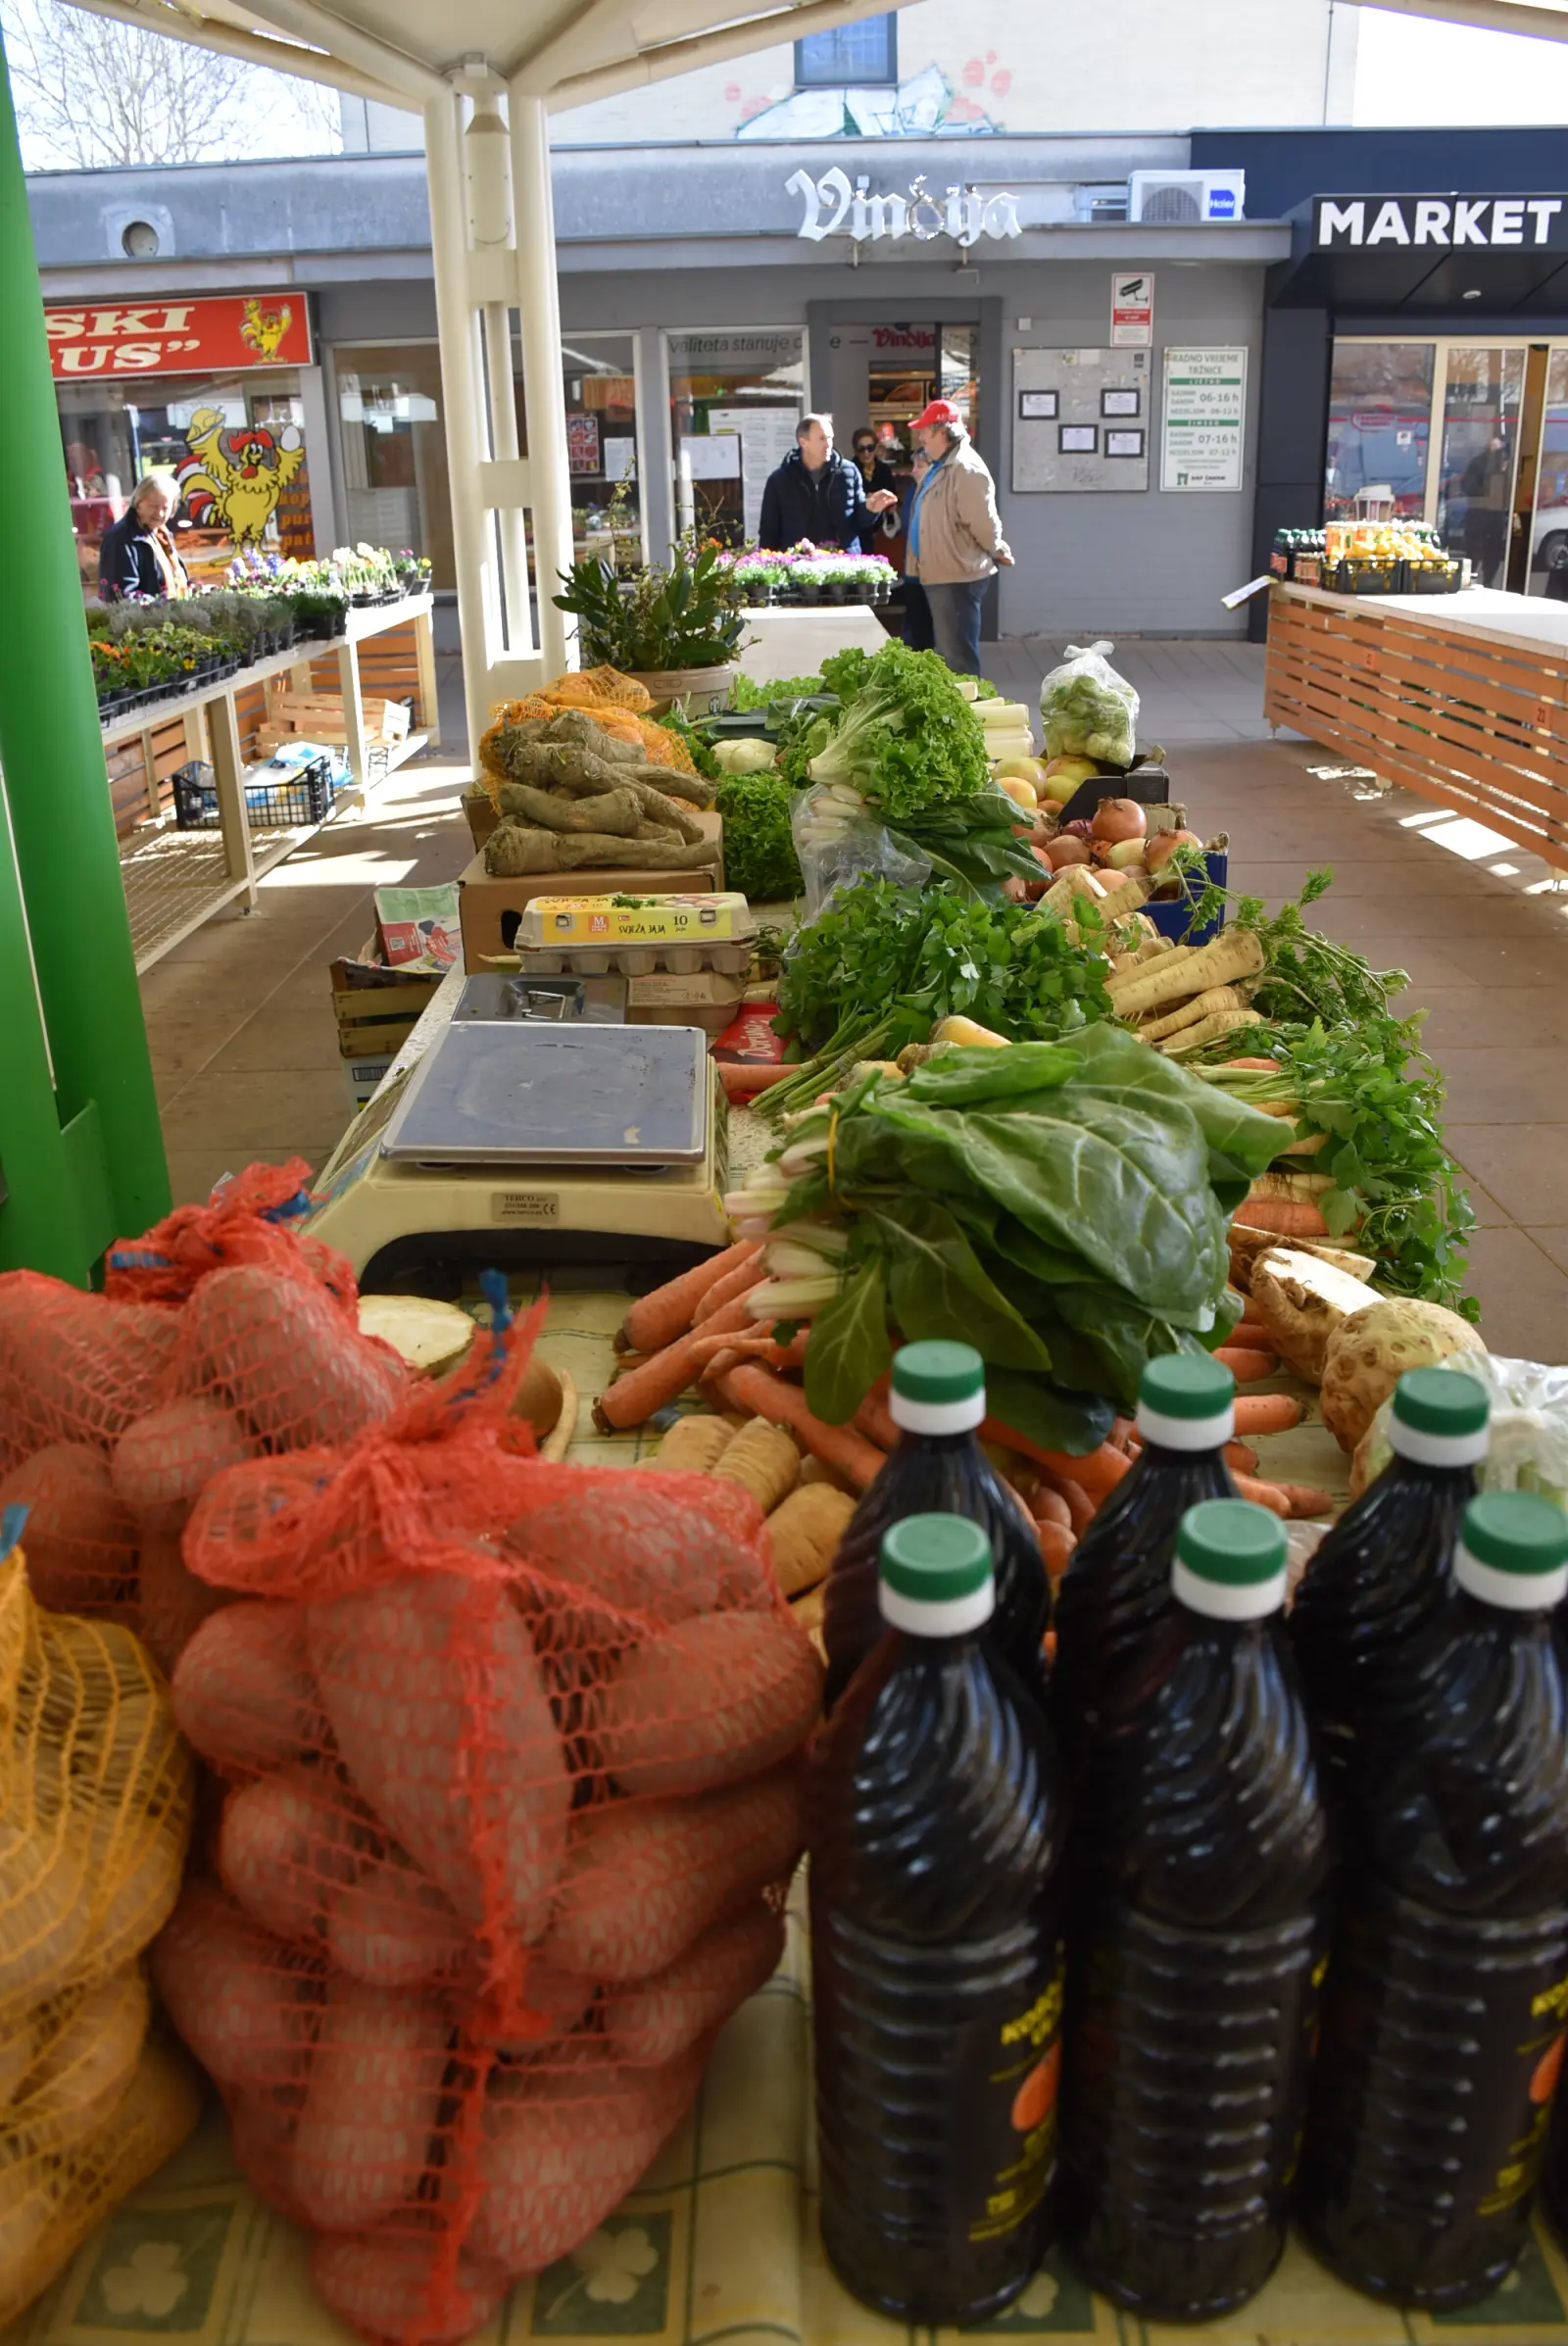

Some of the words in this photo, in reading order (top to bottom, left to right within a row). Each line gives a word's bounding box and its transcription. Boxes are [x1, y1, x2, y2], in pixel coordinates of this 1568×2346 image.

[784, 166, 1023, 247] Vindija
[1209, 198, 1235, 209] Haier
[1319, 200, 1562, 245] MARKET
[46, 307, 195, 340] SKI
[732, 334, 790, 353] stanuje
[50, 339, 201, 371] US”
[1172, 354, 1203, 363] RADNO
[1204, 354, 1239, 363] VRIJEME
[1188, 365, 1222, 374] TRŽNICE
[1200, 393, 1230, 402] 06-16
[1233, 393, 1239, 402] h
[1198, 435, 1230, 444] 07-16
[1231, 434, 1237, 444] h
[673, 915, 688, 926] 10
[618, 923, 646, 935] SVJEŽA
[648, 924, 665, 935] JAJA
